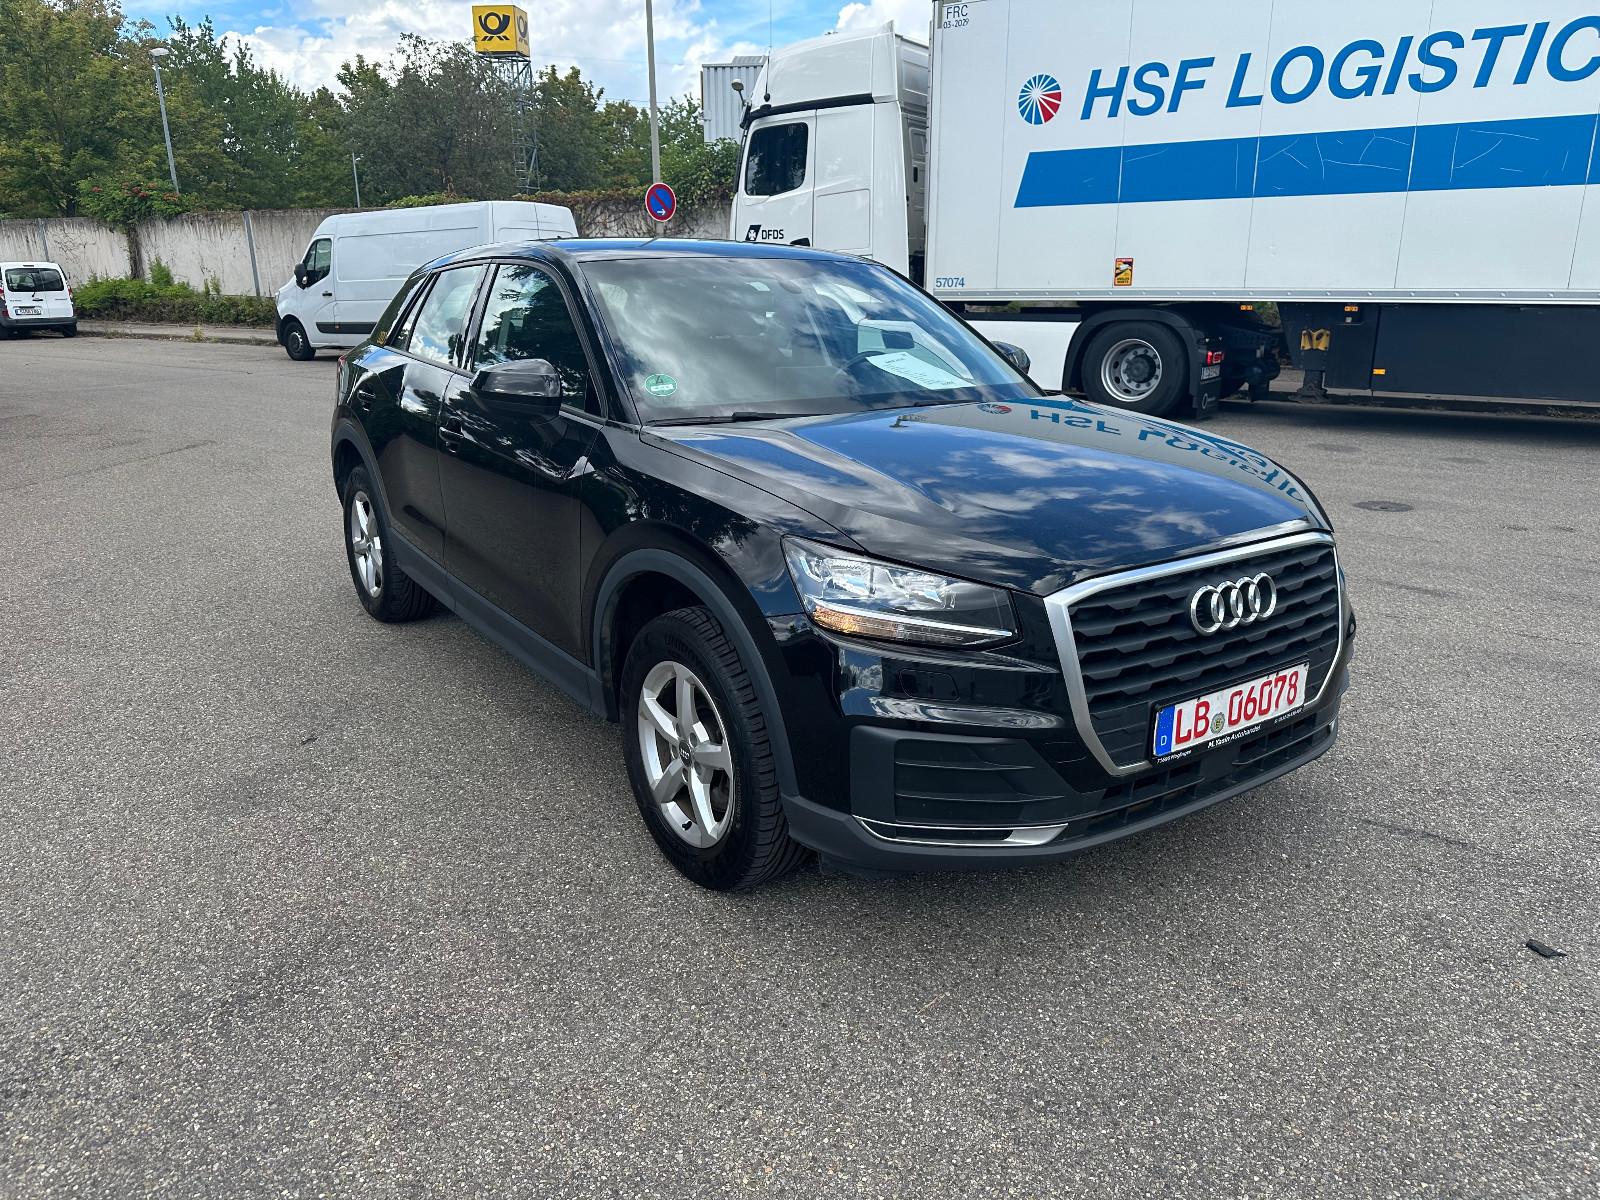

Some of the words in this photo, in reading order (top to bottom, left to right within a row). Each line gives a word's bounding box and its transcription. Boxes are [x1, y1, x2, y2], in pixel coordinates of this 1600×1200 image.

[946, 4, 969, 19] FRC
[1080, 57, 1215, 120] HSF
[1225, 15, 1600, 109] LOGISTIC
[761, 229, 785, 240] DFDS
[935, 277, 966, 288] 57074
[1174, 700, 1210, 745] LB
[1227, 670, 1299, 727] 06078
[1160, 735, 1167, 746] D
